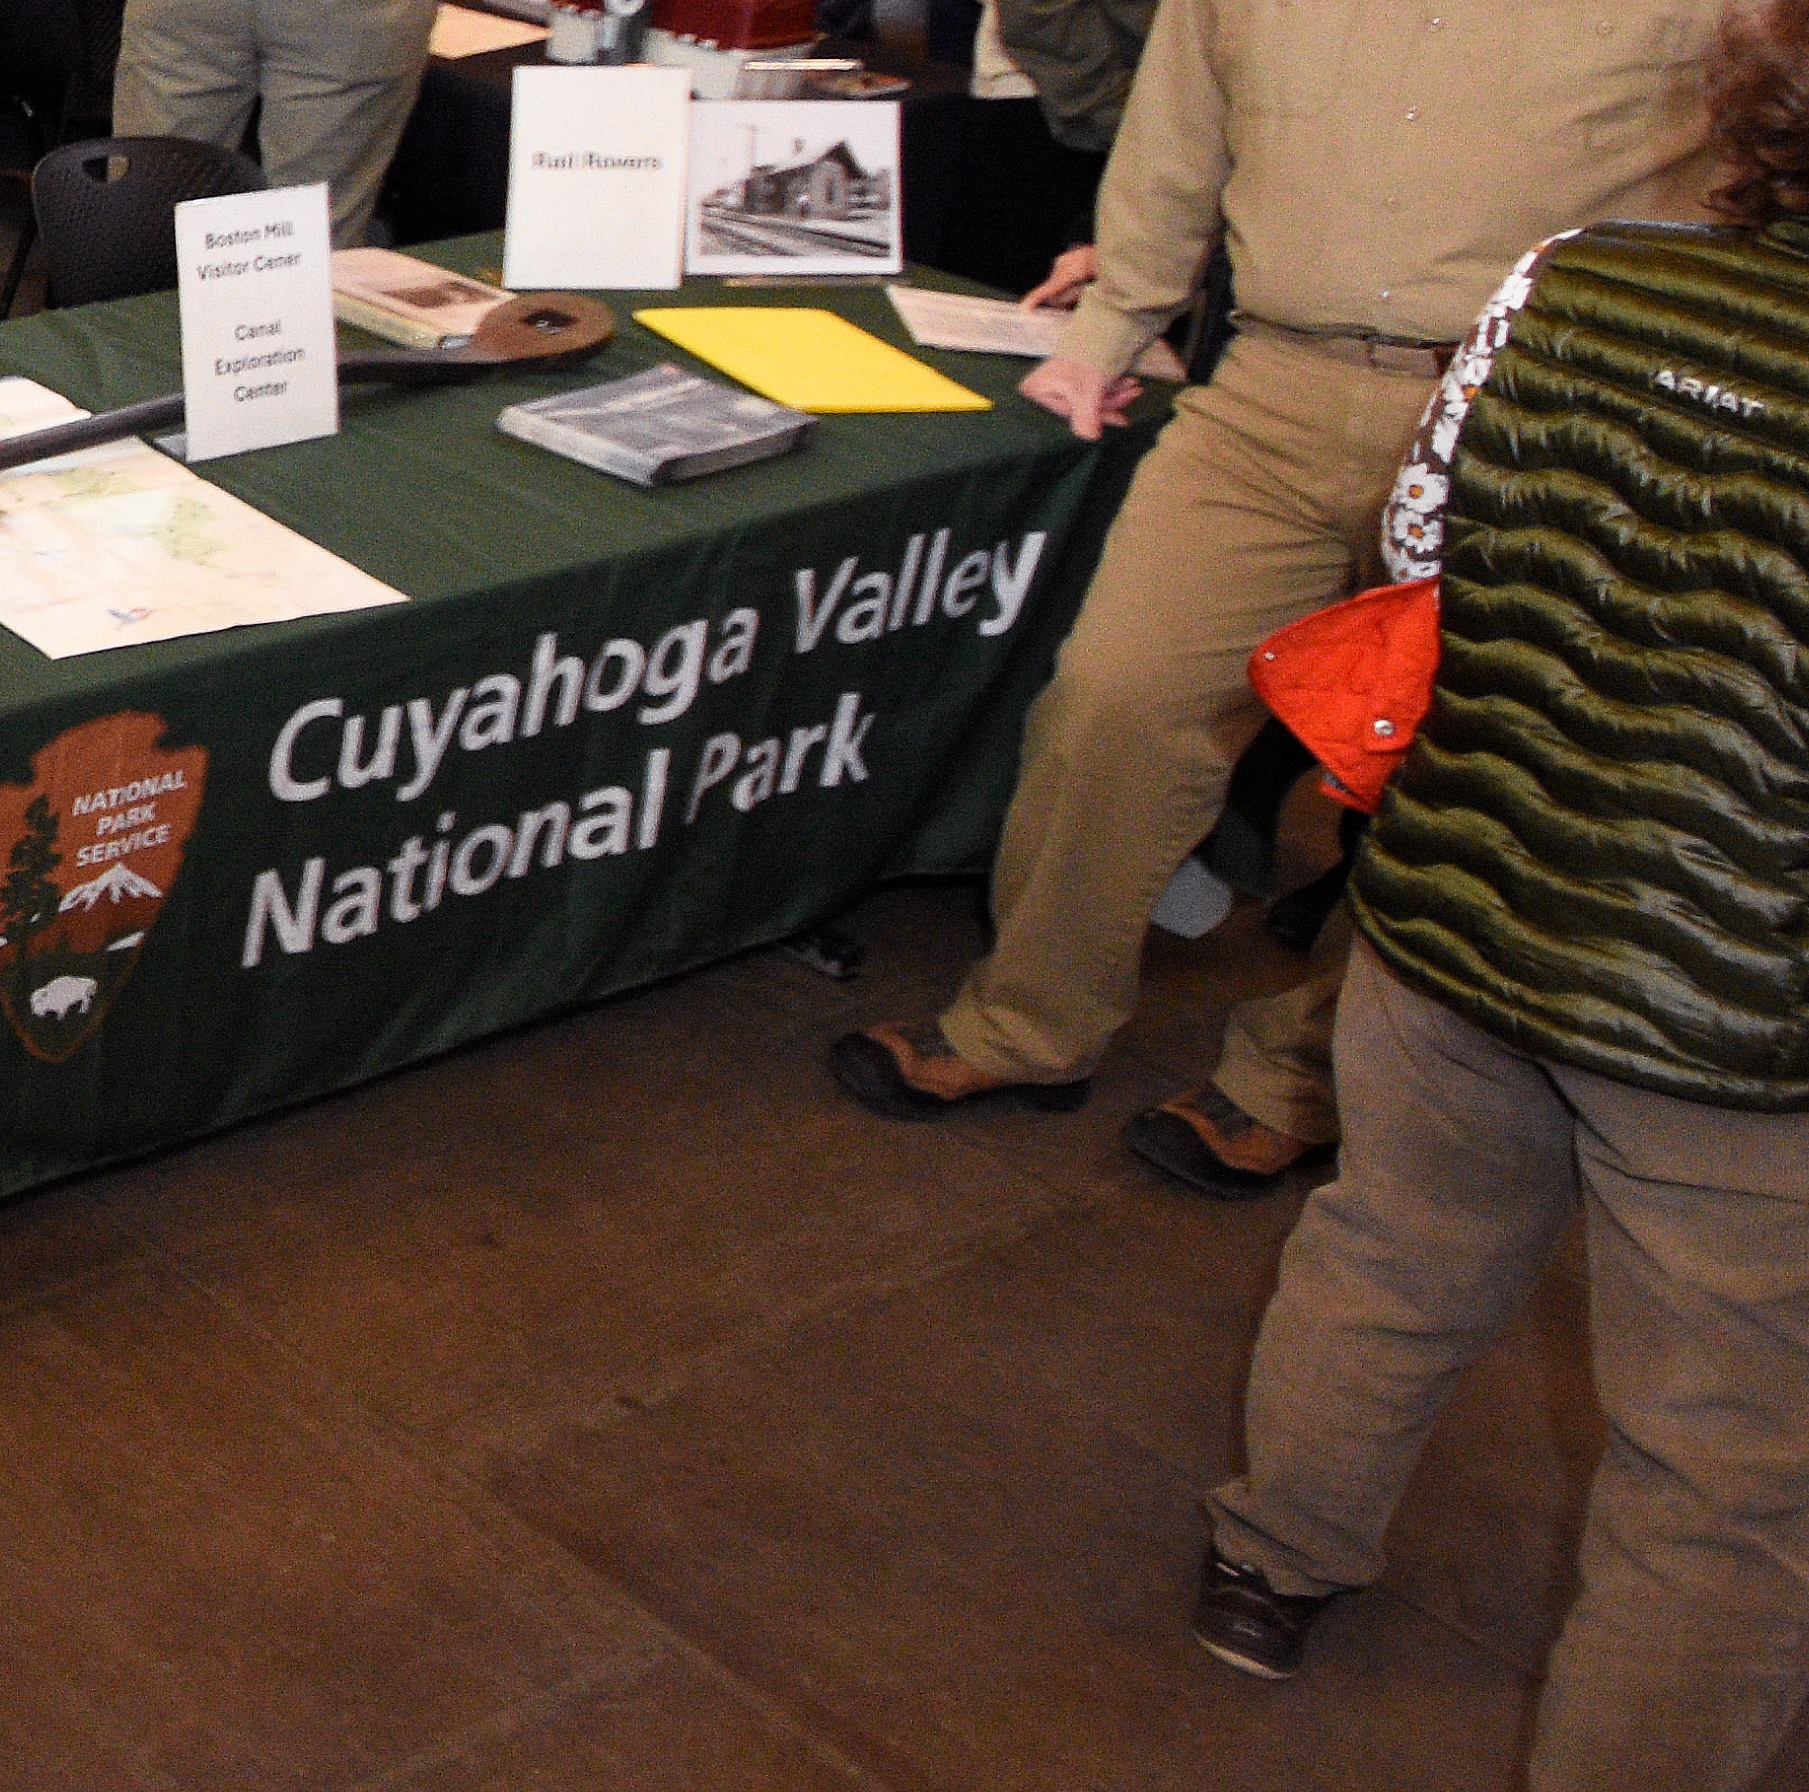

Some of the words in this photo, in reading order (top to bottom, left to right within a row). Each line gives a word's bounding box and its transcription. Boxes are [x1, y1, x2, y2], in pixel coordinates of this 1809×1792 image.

[205, 227, 261, 250] Boston
[263, 221, 294, 240] Mill
[197, 260, 249, 282] Visitor
[234, 320, 281, 341] Canal
[214, 347, 305, 376] Exploration
[234, 380, 287, 402] Center
[1654, 368, 1767, 419] ARIAT
[267, 606, 760, 803] Cuyahoga
[794, 527, 1047, 655] Valley
[72, 769, 187, 816] NATIONAL
[96, 802, 157, 836] PARK
[239, 748, 671, 971] National
[684, 692, 876, 825] Park
[75, 824, 172, 867] SERVICE
